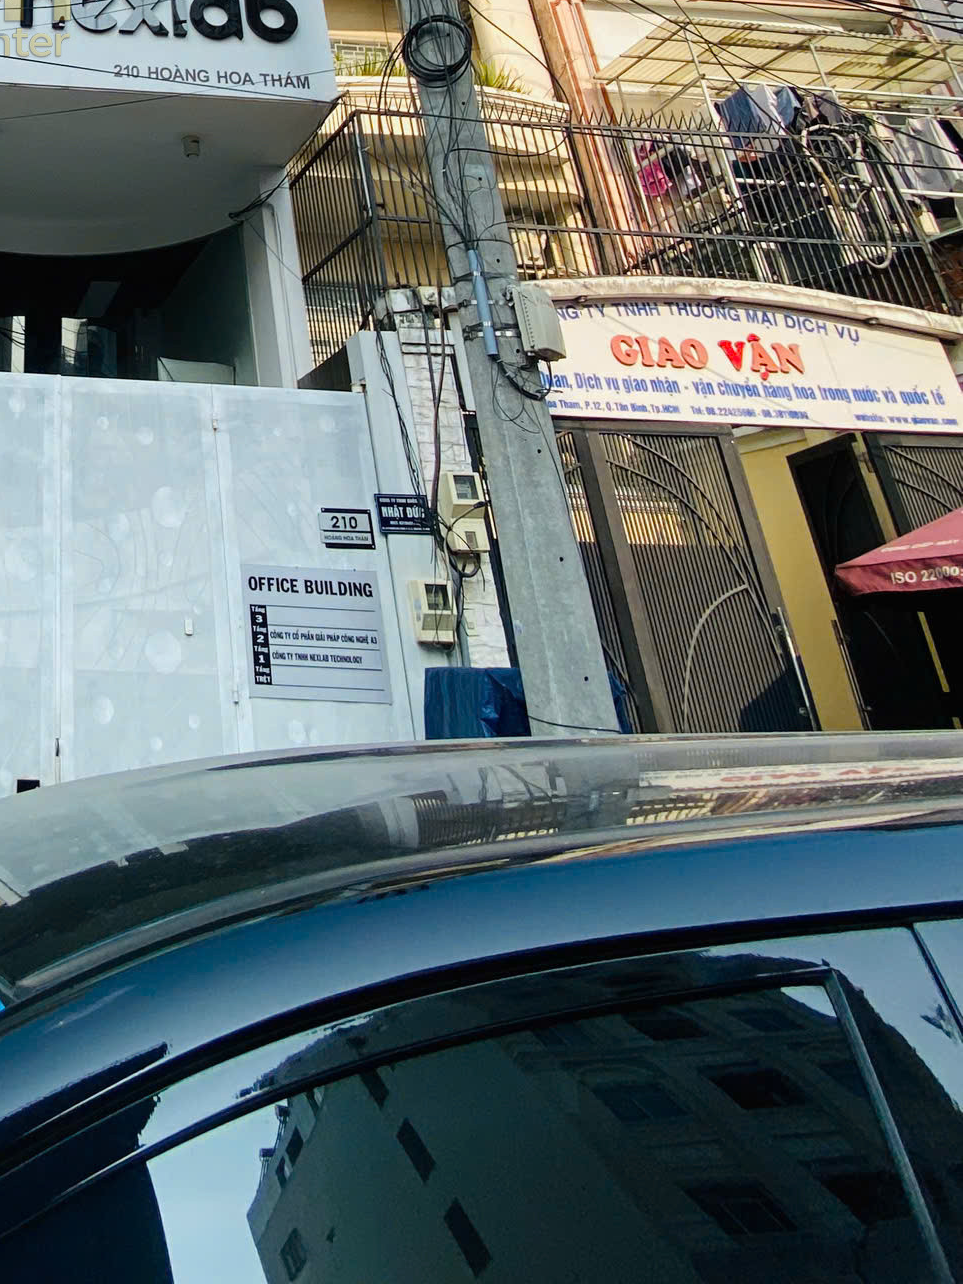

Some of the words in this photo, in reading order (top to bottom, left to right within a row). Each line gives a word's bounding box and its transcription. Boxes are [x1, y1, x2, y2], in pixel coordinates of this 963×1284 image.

[114, 65, 139, 78] 210
[148, 65, 210, 82] HOÀNG
[217, 71, 254, 86] HOA
[259, 71, 311, 89] THÁM
[583, 304, 607, 319] TY
[611, 302, 661, 317] TNHH
[664, 302, 742, 322] THƯƠNG
[746, 310, 779, 329] MẠI
[784, 314, 829, 336] DỊCH
[834, 325, 861, 347] VỤ
[610, 334, 709, 370] GIAO
[717, 332, 805, 381] VẬN
[574, 372, 603, 392] Dịch
[604, 376, 621, 394] vụ
[622, 376, 648, 394] giao
[649, 377, 681, 396] nhận
[692, 377, 715, 398] vận
[717, 377, 761, 399] chuyển
[817, 384, 852, 404] trong
[851, 384, 881, 403] nước
[881, 387, 898, 404] và
[899, 384, 929, 406] quốc
[930, 385, 945, 405] tế
[381, 505, 404, 519] NHẬT
[331, 516, 357, 529] 210
[890, 570, 917, 584] ISO
[248, 576, 299, 594] OFFICE
[304, 579, 374, 597] BUILDING
[255, 615, 263, 623] 3
[256, 635, 264, 643] 2
[270, 629, 284, 639] CÔNG
[284, 631, 291, 640] TY
[258, 655, 266, 663] 1
[272, 650, 286, 660] CÔNG
[287, 652, 293, 660] TY
